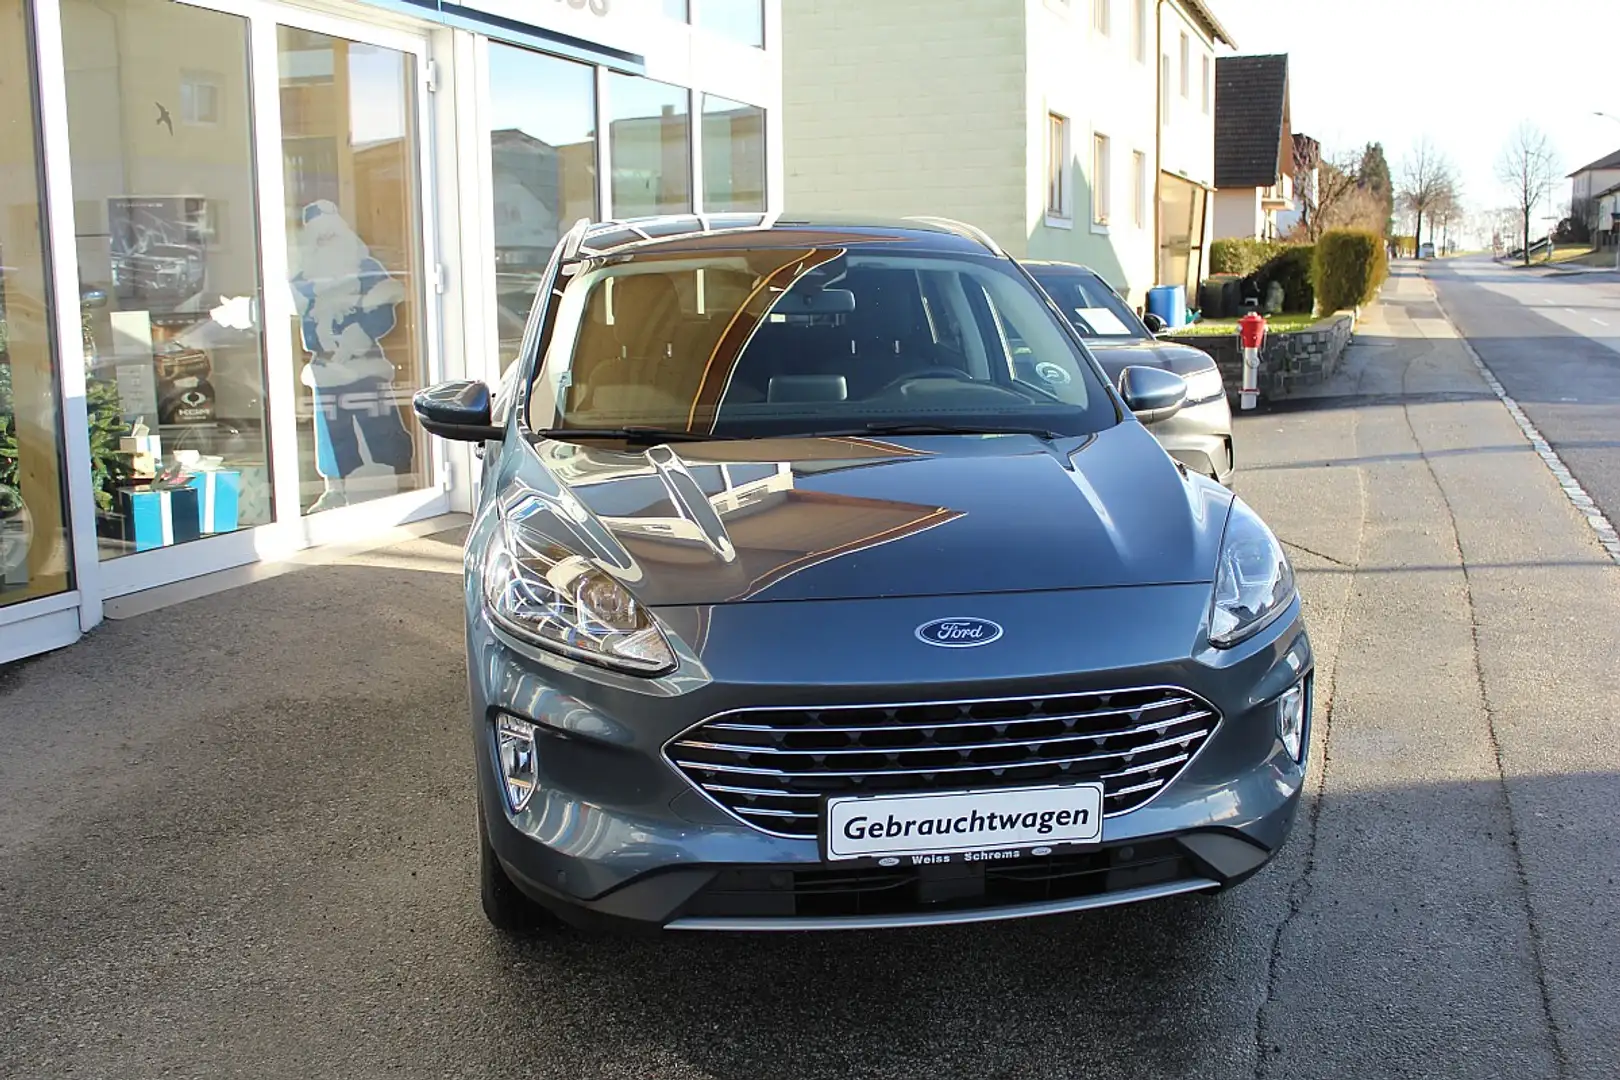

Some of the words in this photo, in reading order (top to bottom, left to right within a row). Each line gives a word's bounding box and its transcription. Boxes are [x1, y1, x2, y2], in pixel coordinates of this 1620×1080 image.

[937, 622, 983, 639] Ford
[843, 808, 1089, 840] Gebrauchtwagen
[911, 855, 950, 865] Weiss
[964, 850, 1021, 862] Schrems
